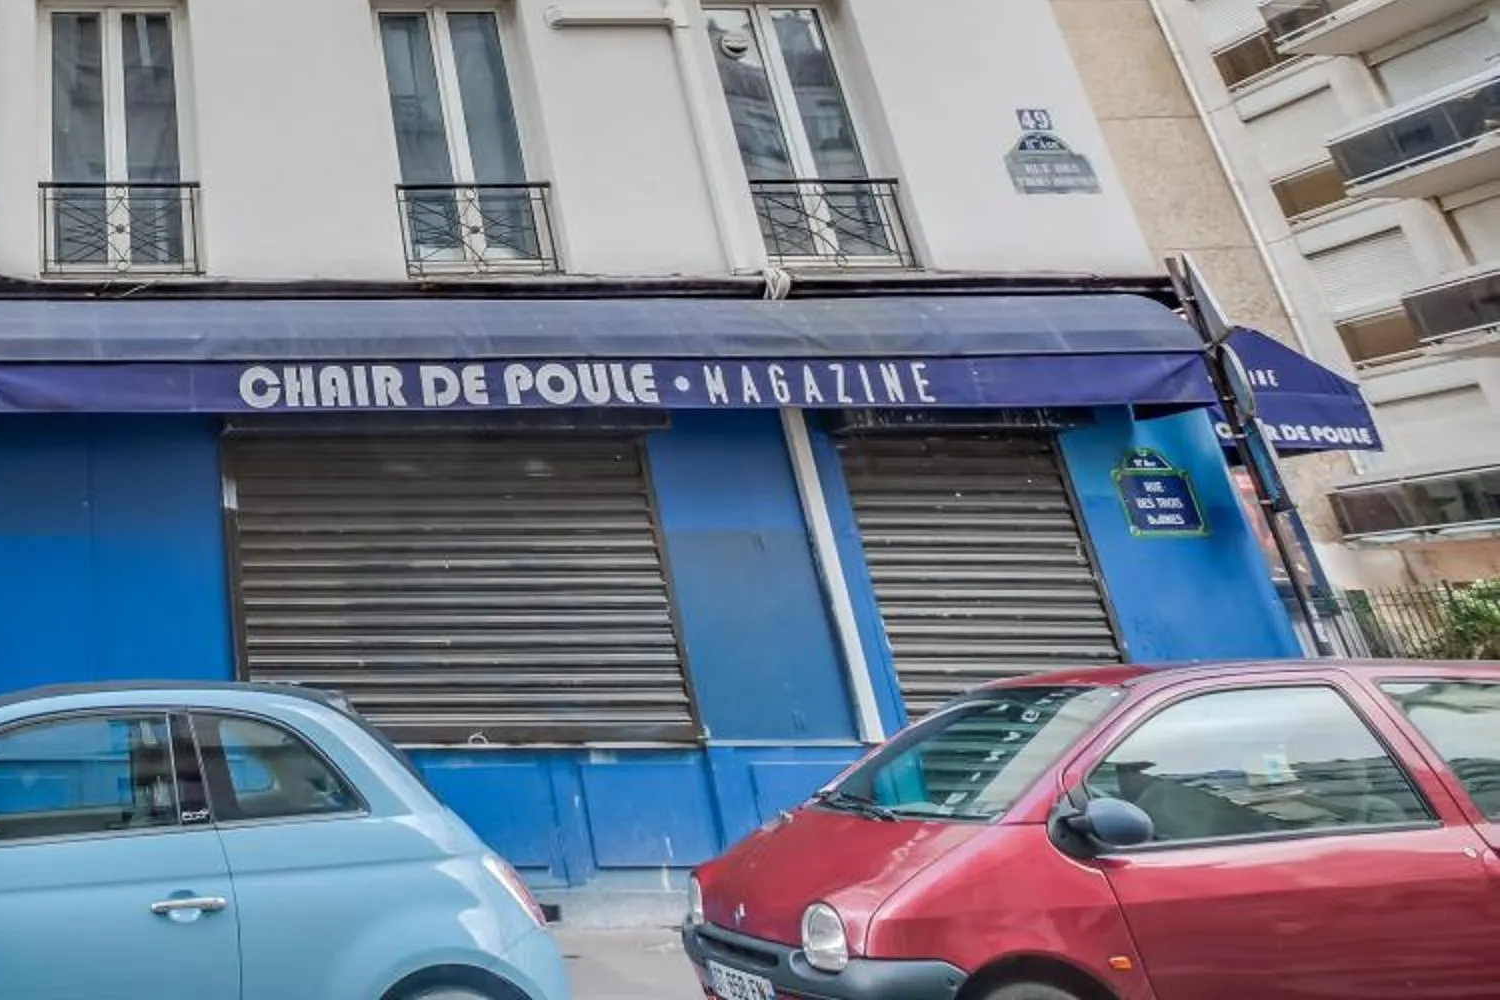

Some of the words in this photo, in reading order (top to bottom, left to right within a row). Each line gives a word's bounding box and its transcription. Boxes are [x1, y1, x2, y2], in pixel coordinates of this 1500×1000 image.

[1020, 110, 1050, 130] 49
[239, 365, 408, 408] CHAIR
[419, 364, 489, 407] DE
[503, 363, 661, 406] POULE
[703, 362, 936, 404] MAGAZINE
[1282, 424, 1310, 441] DE
[1311, 426, 1373, 445] POULE
